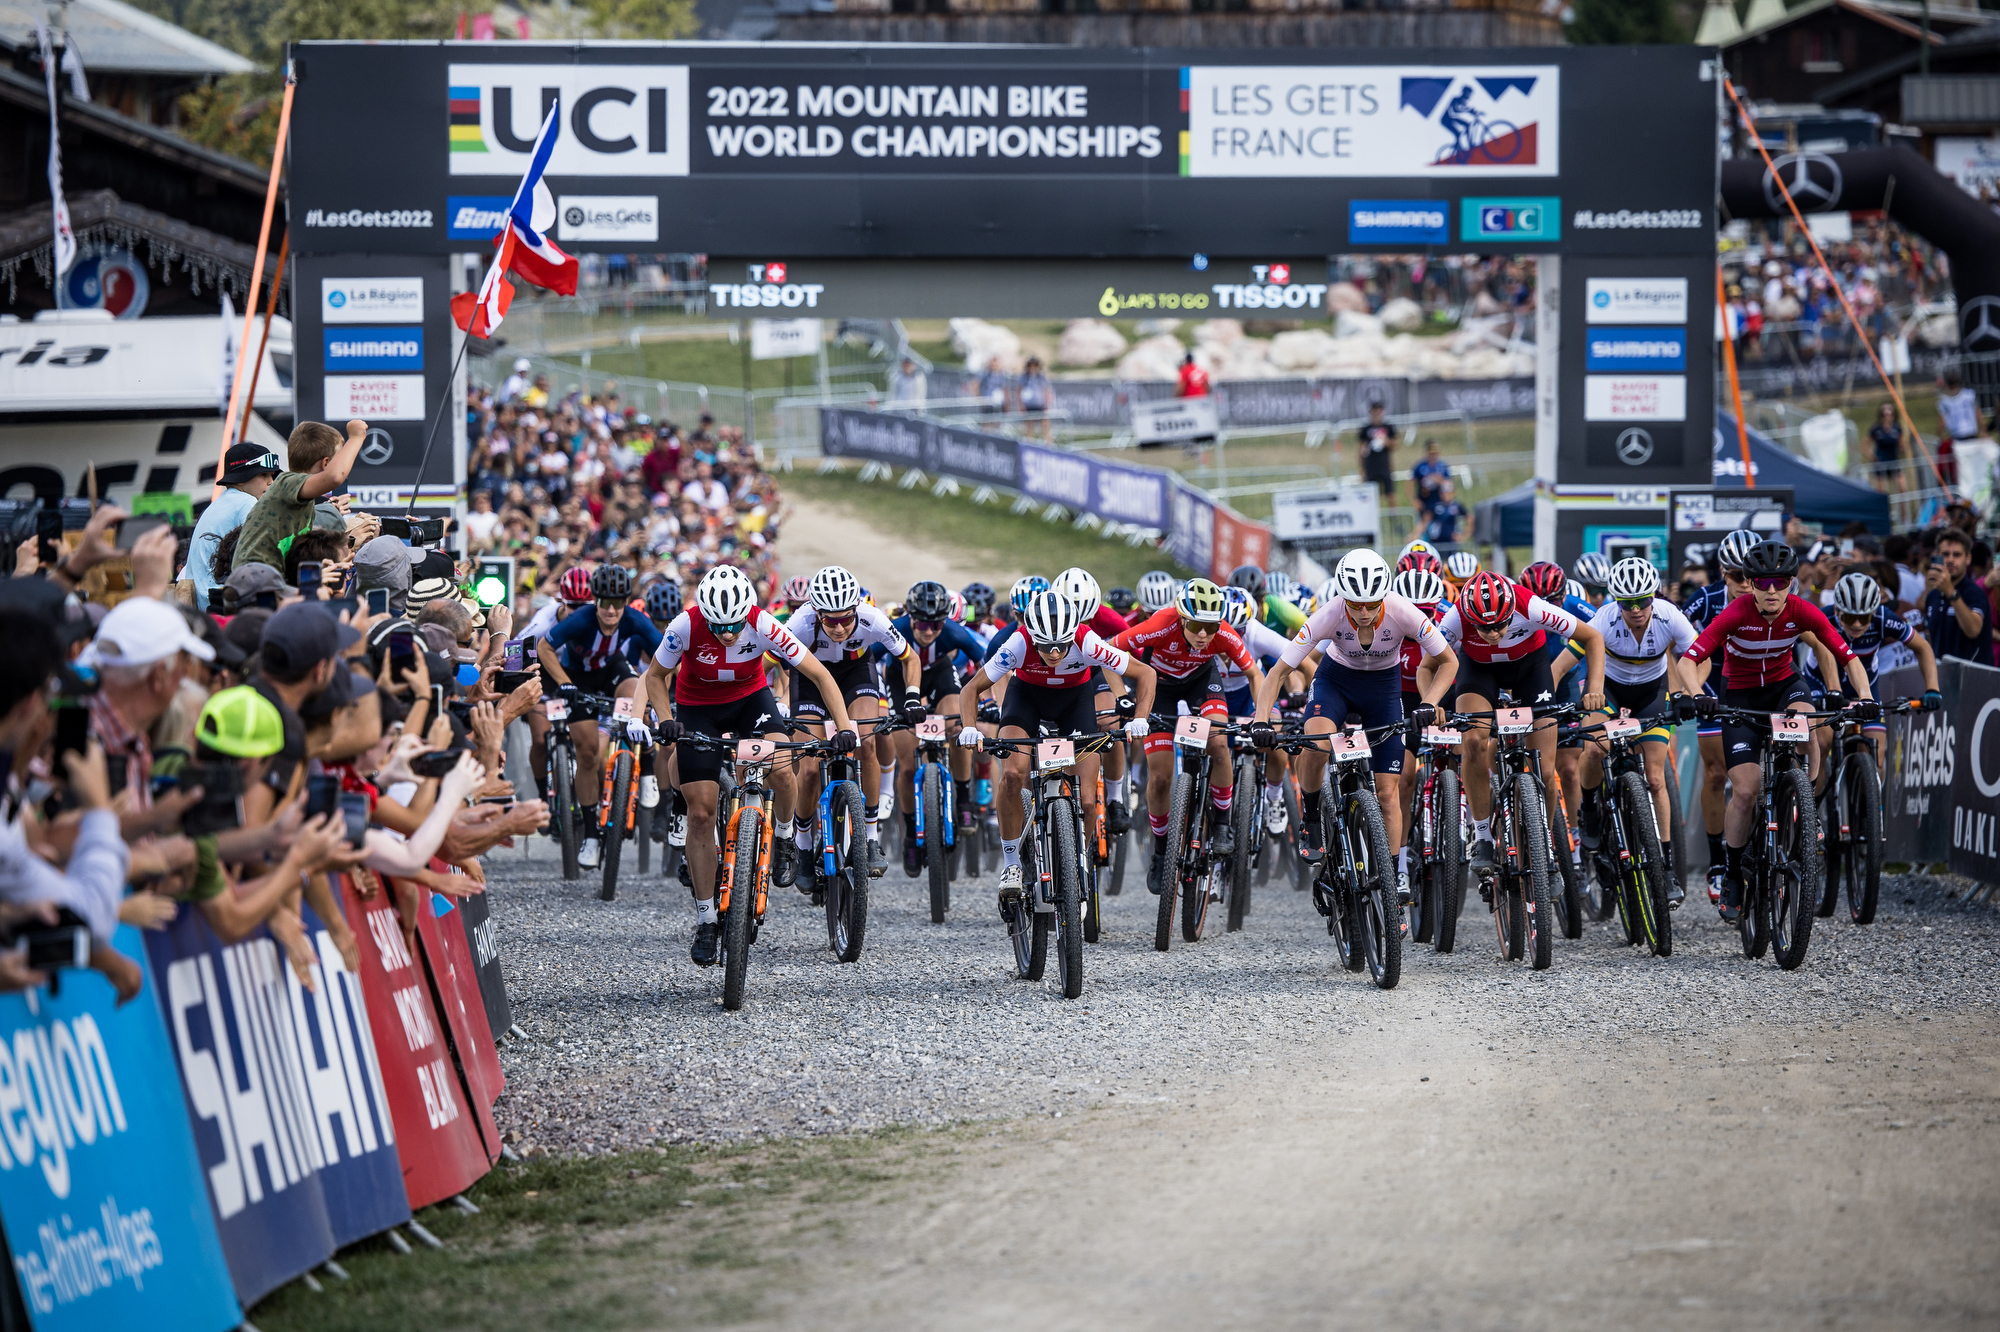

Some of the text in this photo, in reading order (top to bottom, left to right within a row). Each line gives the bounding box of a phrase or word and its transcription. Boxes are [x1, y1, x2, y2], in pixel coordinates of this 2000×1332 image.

[707, 85, 1088, 118] 2022 MOUNTAIN BIKE
[1212, 84, 1380, 116] LES GETS
[492, 86, 667, 154] UCI
[707, 126, 1162, 158] WORLD CHAMPIONSHIPS
[1212, 126, 1353, 158] FRANCE
[305, 209, 434, 228] #LesGets2022
[1354, 211, 1444, 228] SHIMANO
[1485, 207, 1537, 231] CIC
[1573, 209, 1702, 229] #LesGets2022
[350, 287, 418, 303] La Région
[709, 284, 825, 308] TISSOT
[1099, 286, 1209, 317] 6 LAPS TO GO
[1212, 284, 1328, 308] TISSOT
[1615, 288, 1683, 304] La Région
[329, 341, 419, 357] SHIMANO
[1591, 341, 1681, 358] SHIMANO
[350, 381, 398, 391] SAVOIE
[350, 405, 398, 415] BLANC
[360, 489, 392, 503] UCI
[1615, 486, 1651, 503] UCI
[1217, 630, 1243, 647] usqvarna
[1509, 709, 1520, 720] 4
[922, 723, 939, 734] 20
[1188, 722, 1198, 734] 5
[1781, 721, 1799, 729] 10
[751, 744, 762, 757] 9
[1051, 744, 1061, 755] 7
[1344, 740, 1356, 749] 3
[1953, 805, 1998, 859] OAKL
[166, 929, 396, 1221] SHIMAN
